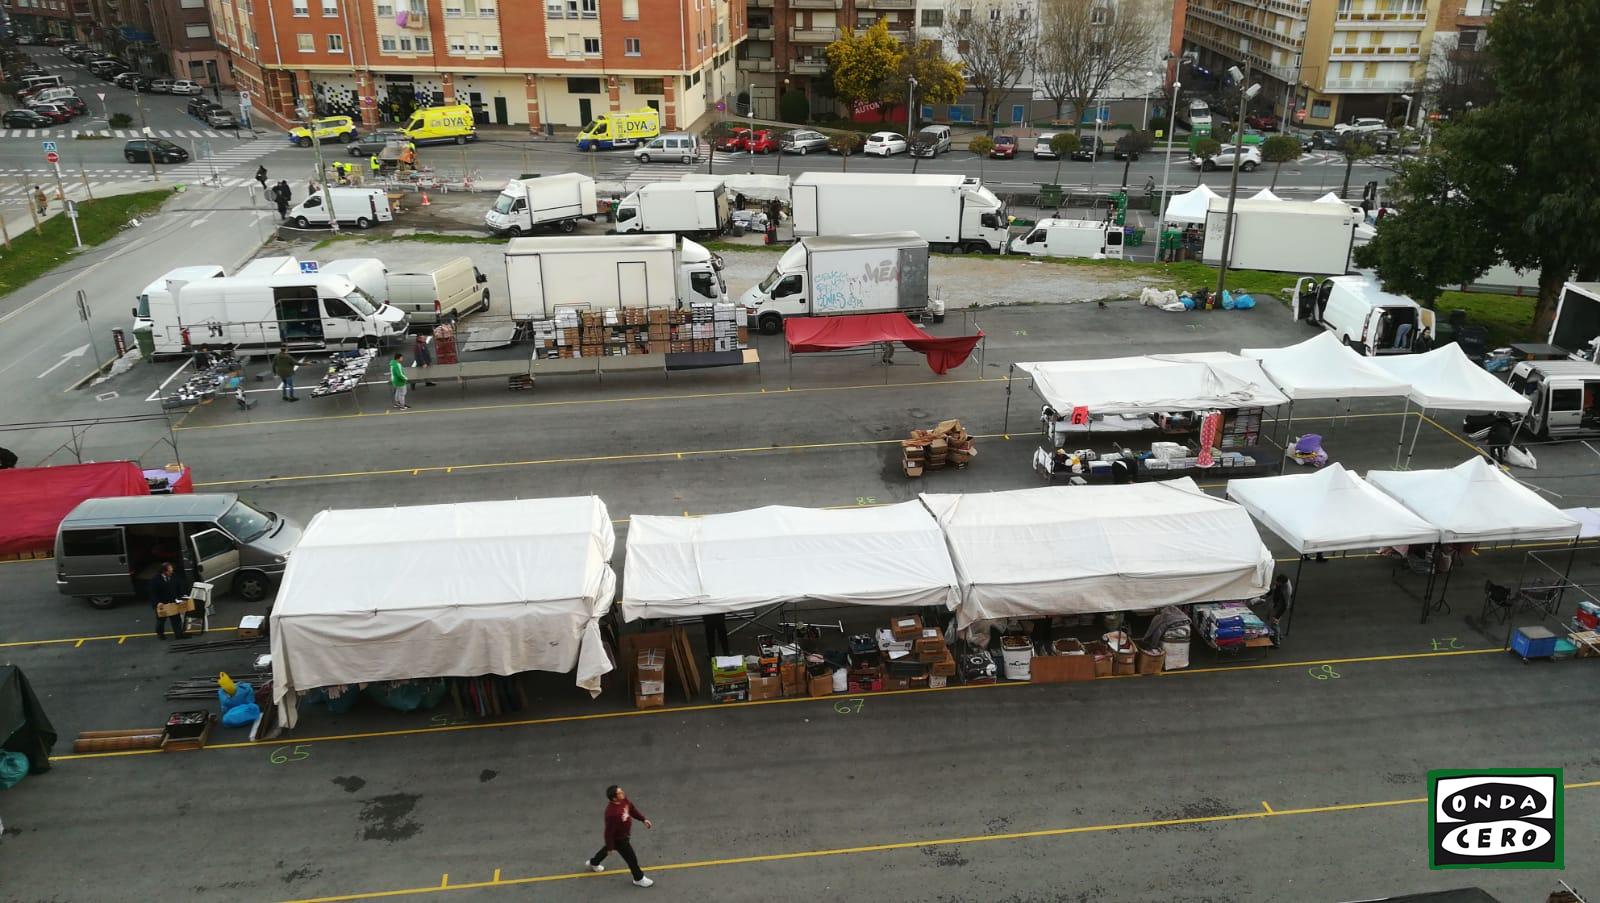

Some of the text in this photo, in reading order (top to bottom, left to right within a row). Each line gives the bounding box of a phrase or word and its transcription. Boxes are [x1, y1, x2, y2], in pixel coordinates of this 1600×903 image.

[443, 117, 464, 127] DYA
[627, 121, 648, 131] DYA
[1074, 413, 1082, 424] 6
[1308, 664, 1341, 680] 68
[833, 698, 865, 714] 67
[270, 743, 313, 764] 65
